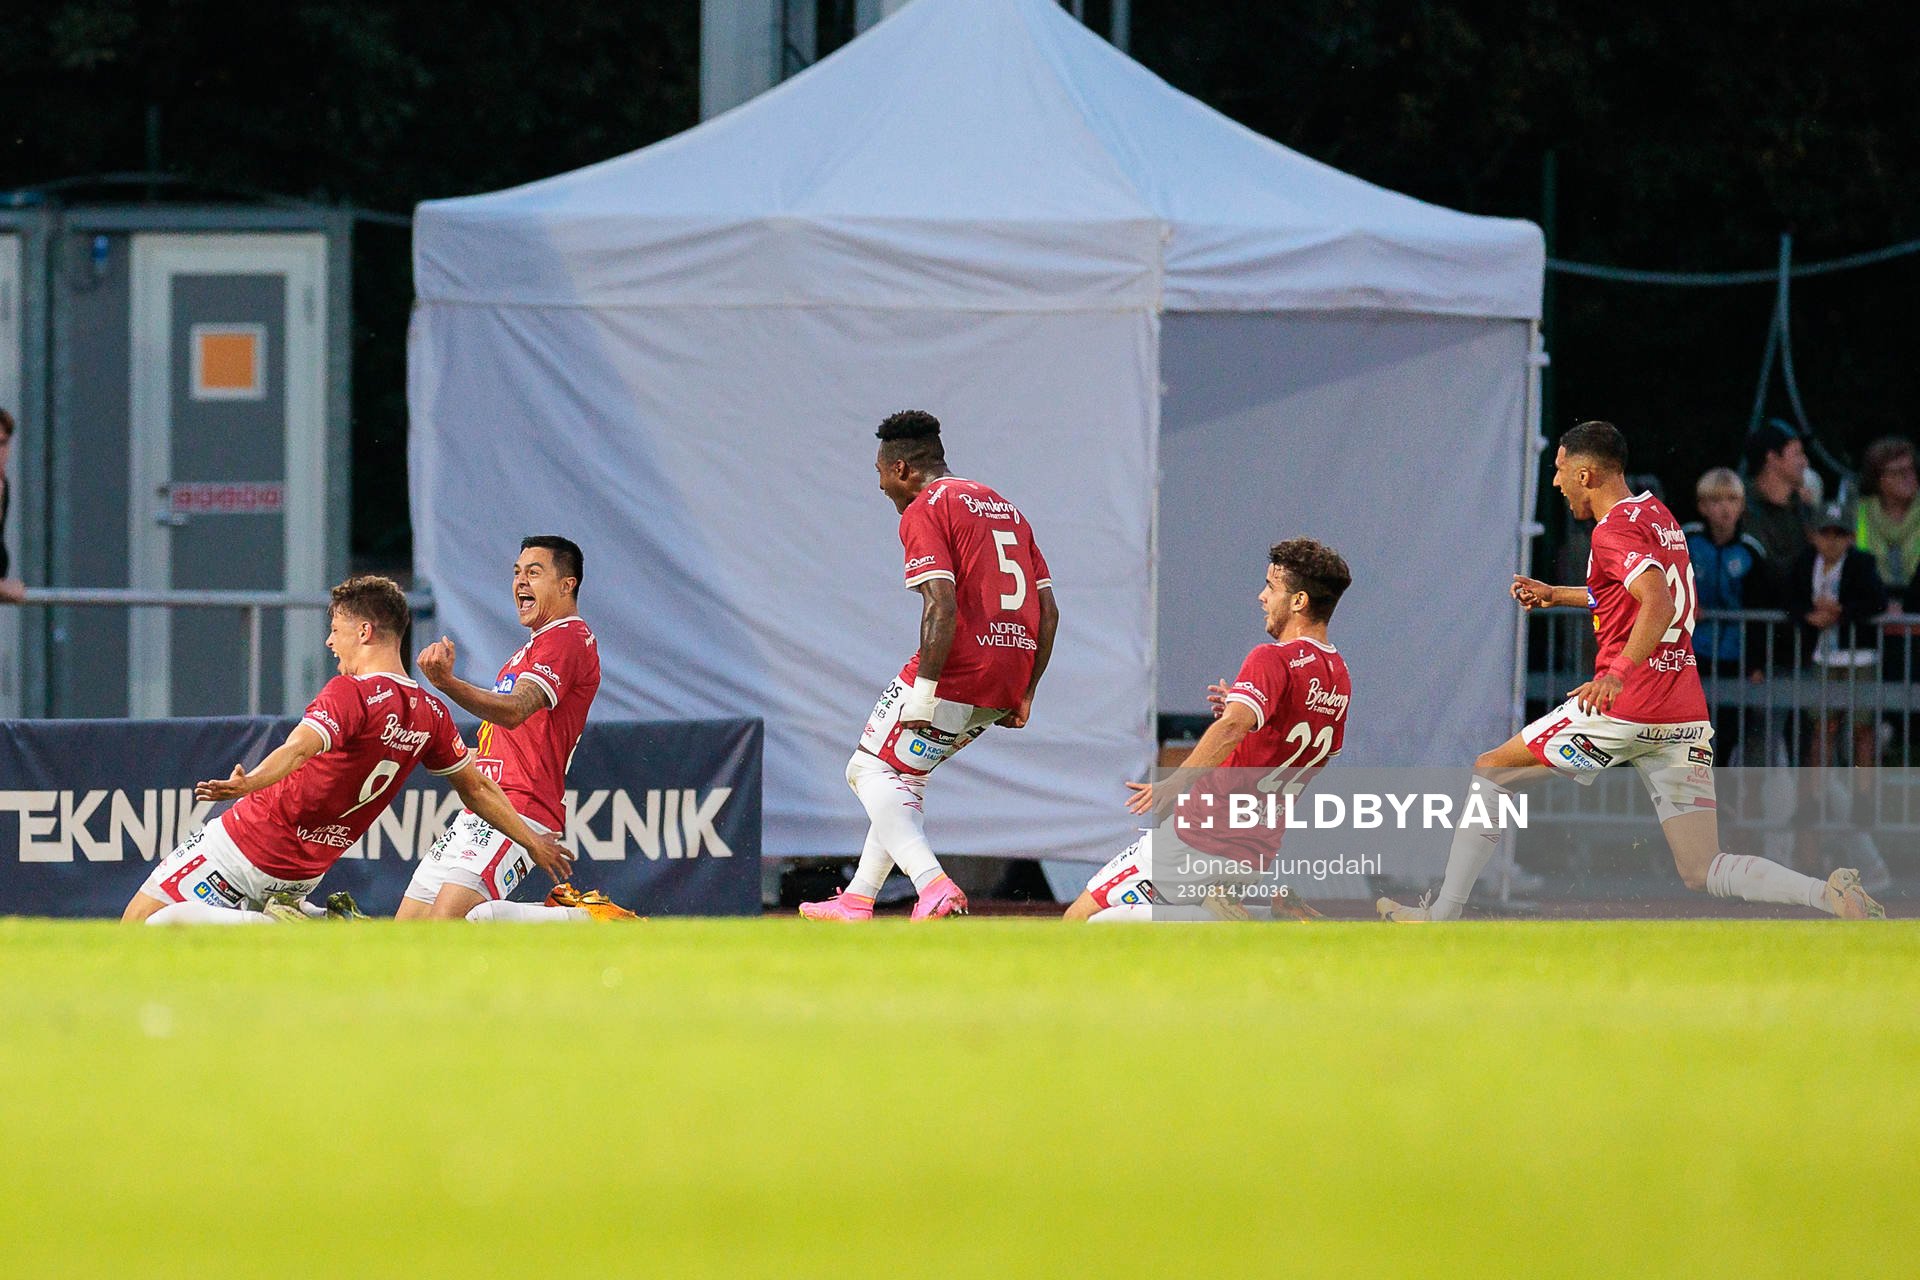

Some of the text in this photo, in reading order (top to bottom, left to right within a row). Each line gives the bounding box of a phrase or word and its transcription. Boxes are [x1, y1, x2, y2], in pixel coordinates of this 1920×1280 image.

[992, 530, 1026, 611] 5
[976, 635, 1037, 650] WELLNESS
[338, 759, 400, 819] 9
[1257, 721, 1334, 796] 22
[563, 787, 733, 861] KNIK
